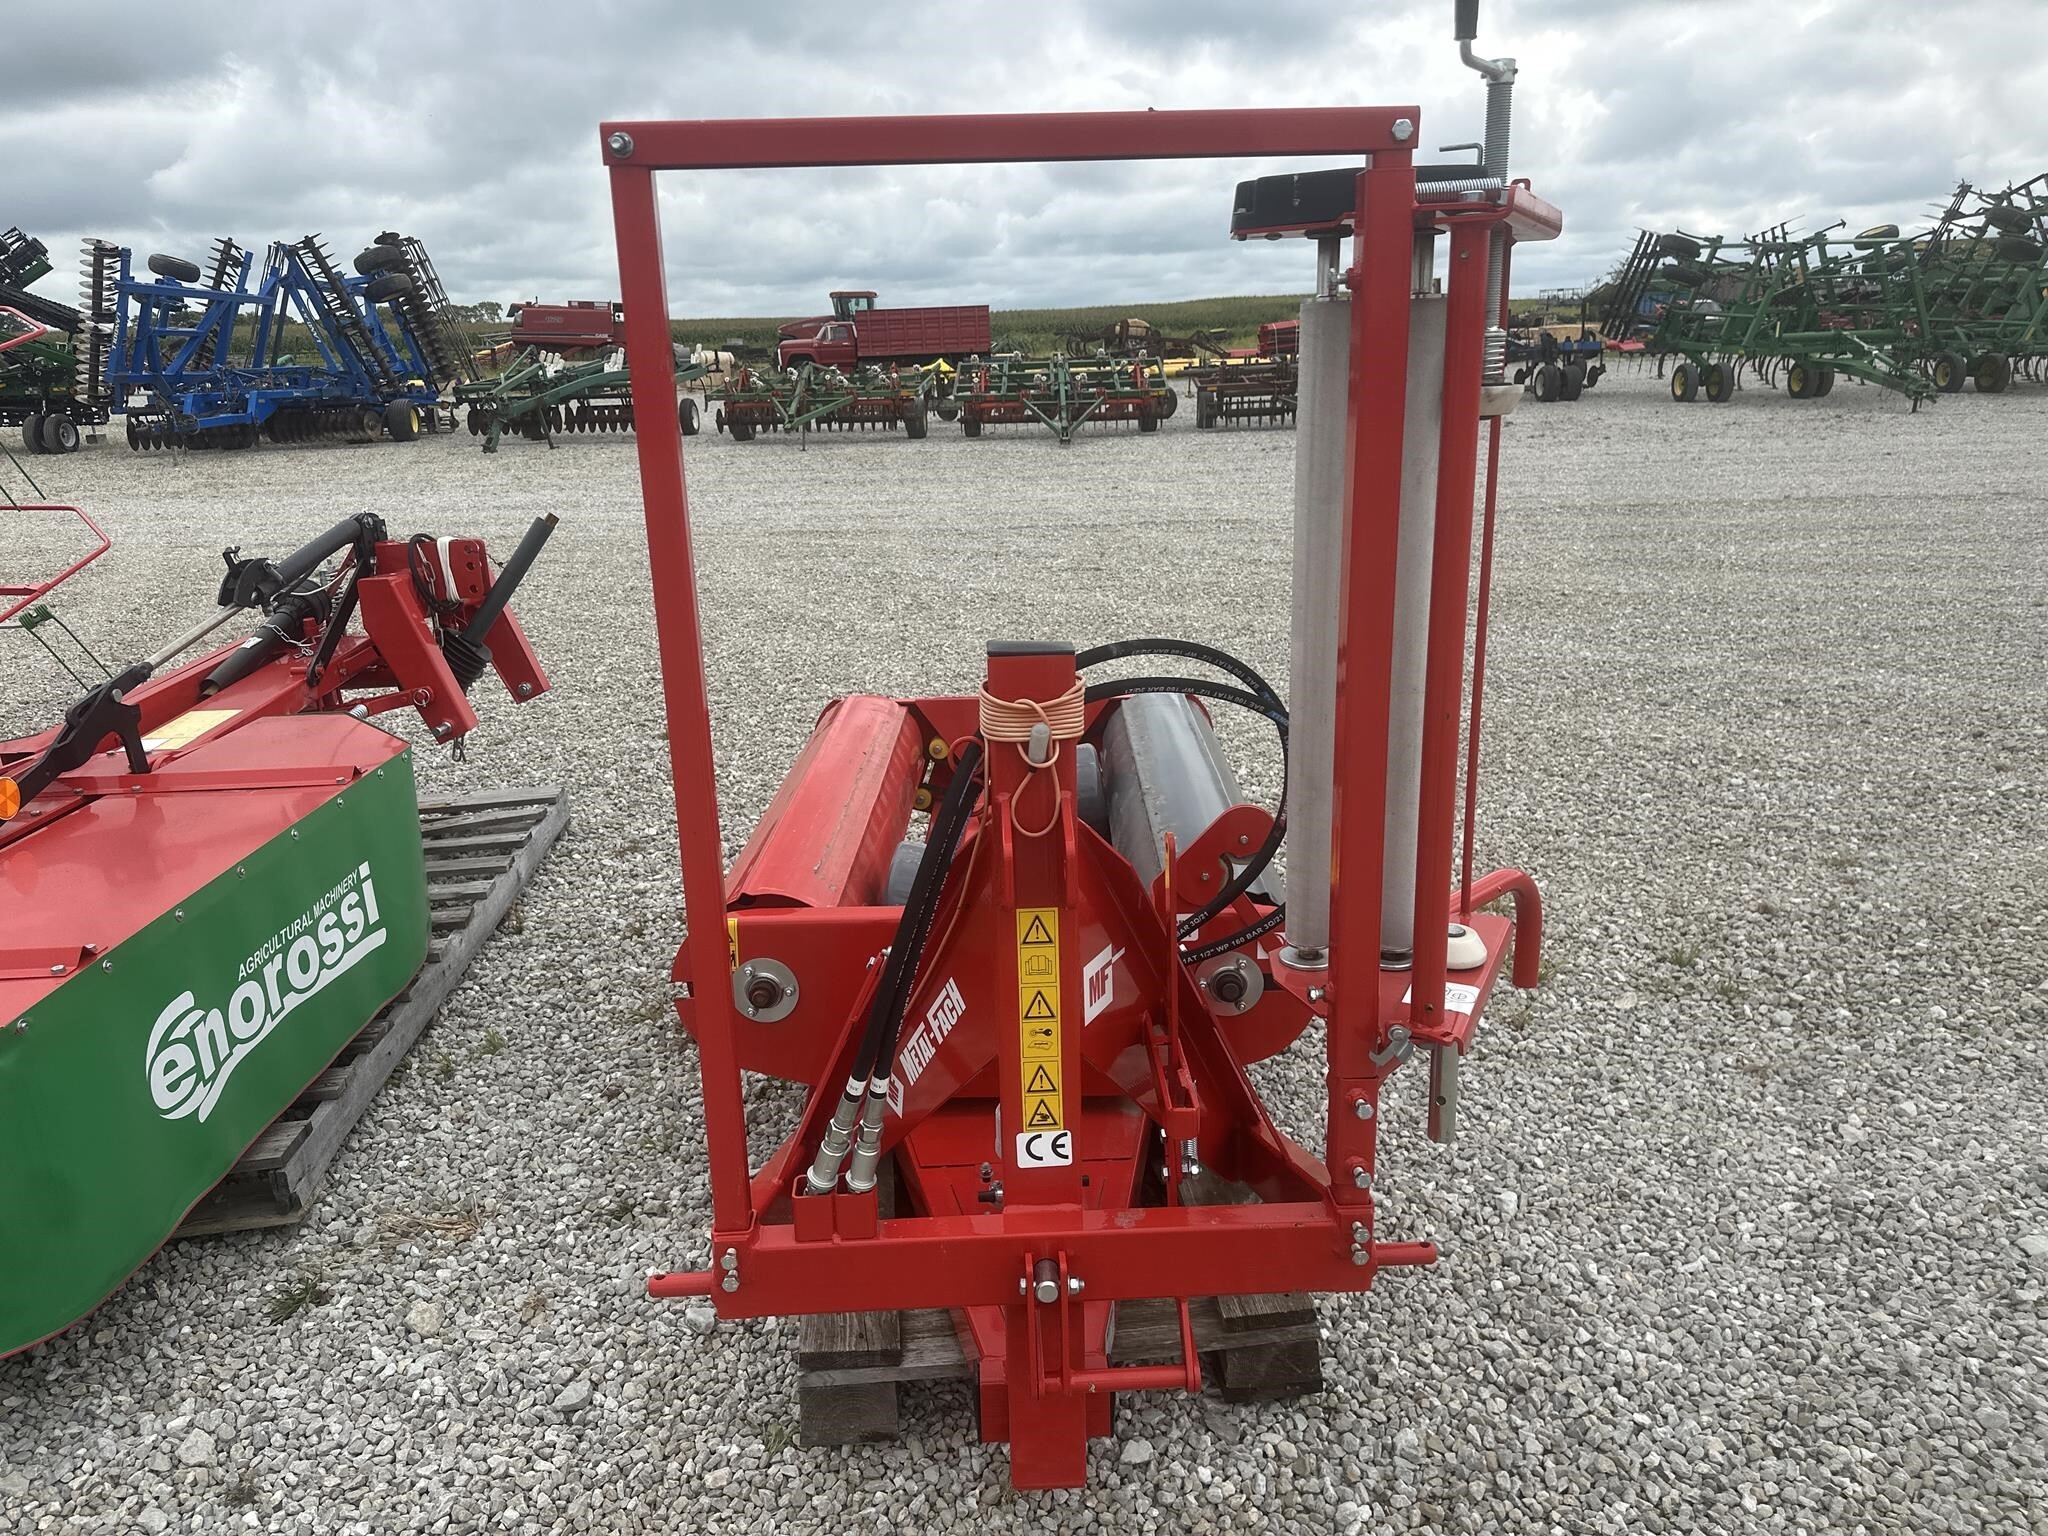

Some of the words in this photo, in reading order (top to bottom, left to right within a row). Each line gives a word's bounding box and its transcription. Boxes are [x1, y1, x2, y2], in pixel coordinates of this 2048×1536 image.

[238, 911, 313, 982] AGRICULTURAL
[313, 868, 359, 920] MACHINERY
[1182, 954, 1198, 965] 1AT
[1215, 943, 1229, 953] WP
[1231, 936, 1245, 946] 160
[1246, 927, 1264, 939] BAR
[899, 976, 967, 1086] METAL-FACH
[1025, 1132, 1069, 1161] CE
